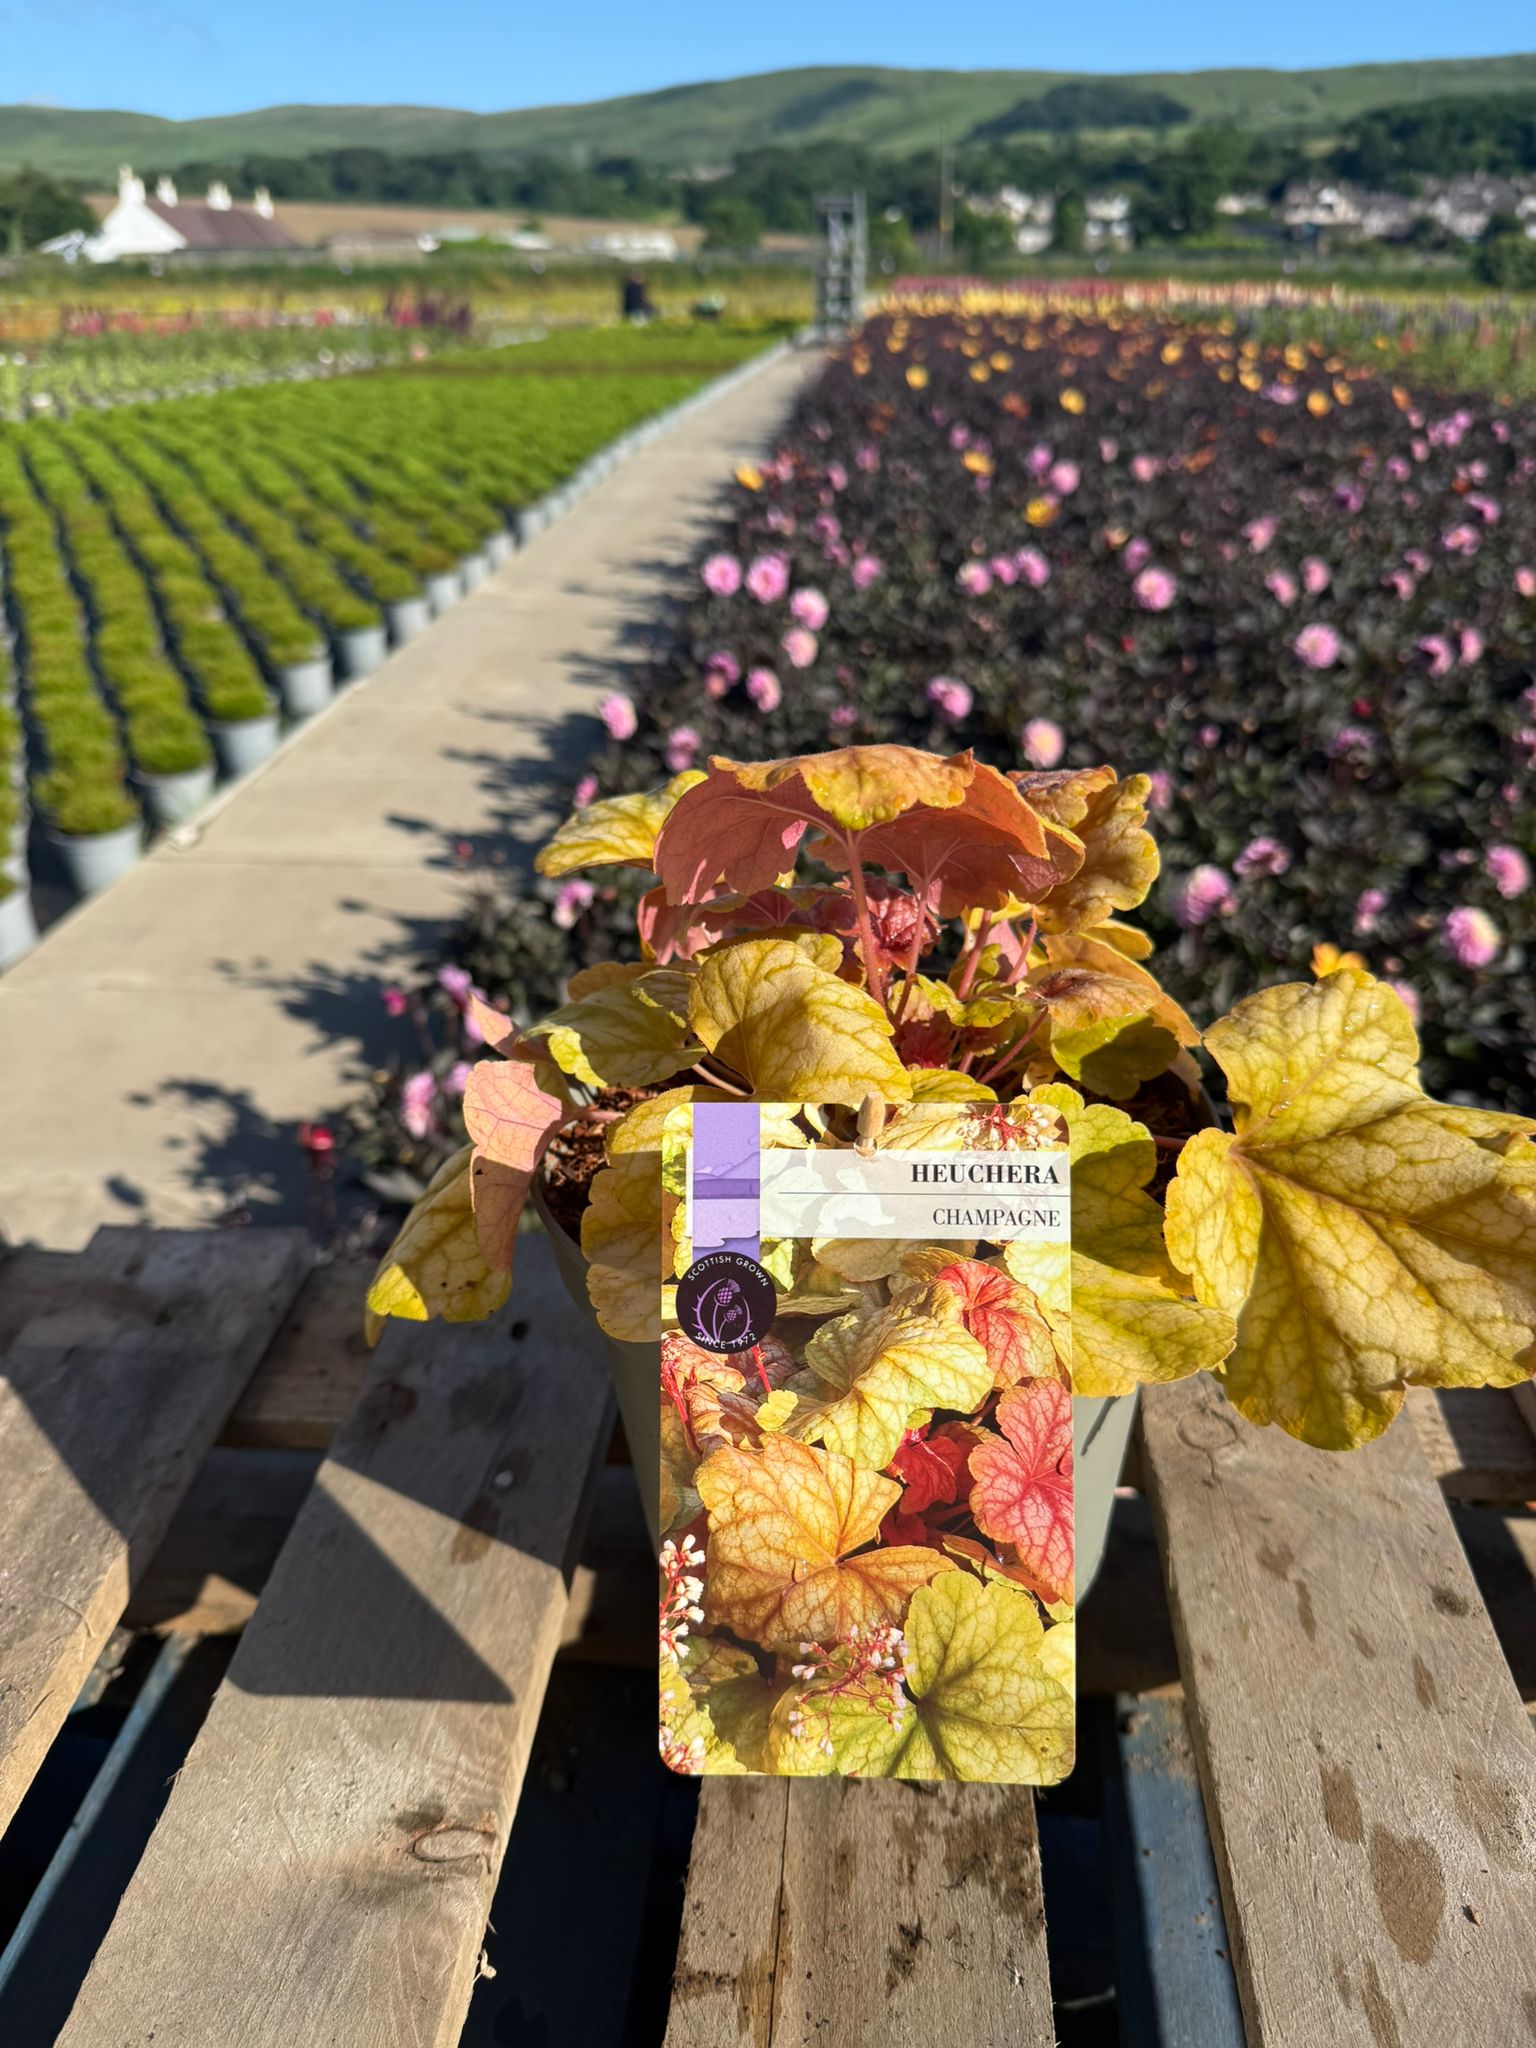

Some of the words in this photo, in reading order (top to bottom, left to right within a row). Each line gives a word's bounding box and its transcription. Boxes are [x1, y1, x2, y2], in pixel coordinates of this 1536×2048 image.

[911, 1163, 1060, 1184] HEUCHERA
[932, 1208, 1061, 1227] CHAMPAGNE
[687, 1255, 732, 1281] SCOTTISH
[735, 1257, 769, 1287] GROWN
[695, 1332, 726, 1349] SINCE
[732, 1332, 757, 1348] 1972
